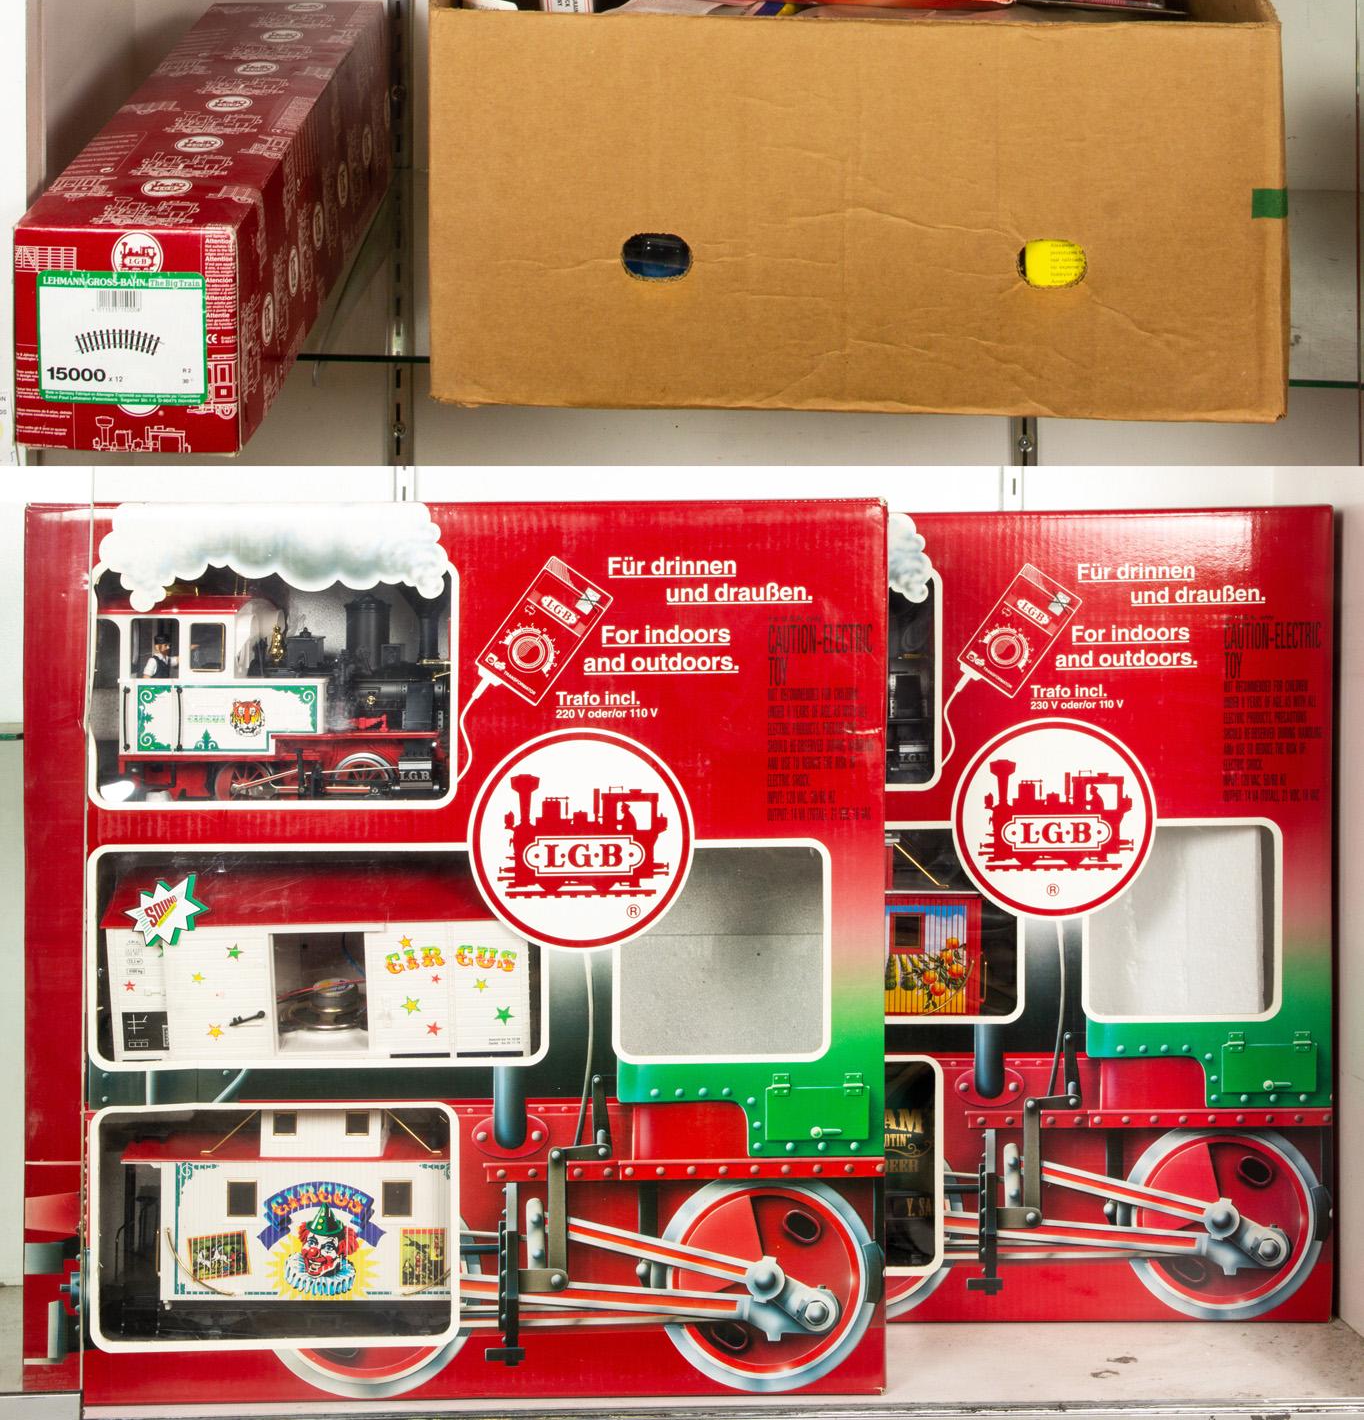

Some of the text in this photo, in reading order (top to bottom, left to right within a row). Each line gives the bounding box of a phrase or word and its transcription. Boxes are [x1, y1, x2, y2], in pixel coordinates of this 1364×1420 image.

[149, 279, 200, 289] The Big Train
[46, 366, 106, 382] 15000
[608, 555, 737, 575] Für drinnen
[1078, 562, 1196, 580] Für drinnen
[666, 583, 813, 602] und draußen.
[1131, 585, 1266, 603] und draußen.
[601, 624, 731, 644] For indoors
[767, 623, 873, 654] CAUTION-ELECTRIC
[1072, 624, 1190, 642] For indoors
[1223, 621, 1322, 650] CAUTION-ELECTRIC
[583, 653, 740, 672] and outdoors.
[1055, 649, 1198, 668] and outdoors.
[1224, 652, 1243, 679] TOY
[767, 656, 788, 685] TOY
[556, 691, 640, 707] Trafo incl.
[1031, 683, 1107, 698] Trafo incl.
[556, 708, 659, 719] 220 V oder/or 110 V
[1030, 699, 1124, 710] 230 V oder/or 110 V
[143, 895, 178, 928] SOUND
[269, 1183, 368, 1216] CIRCUS
